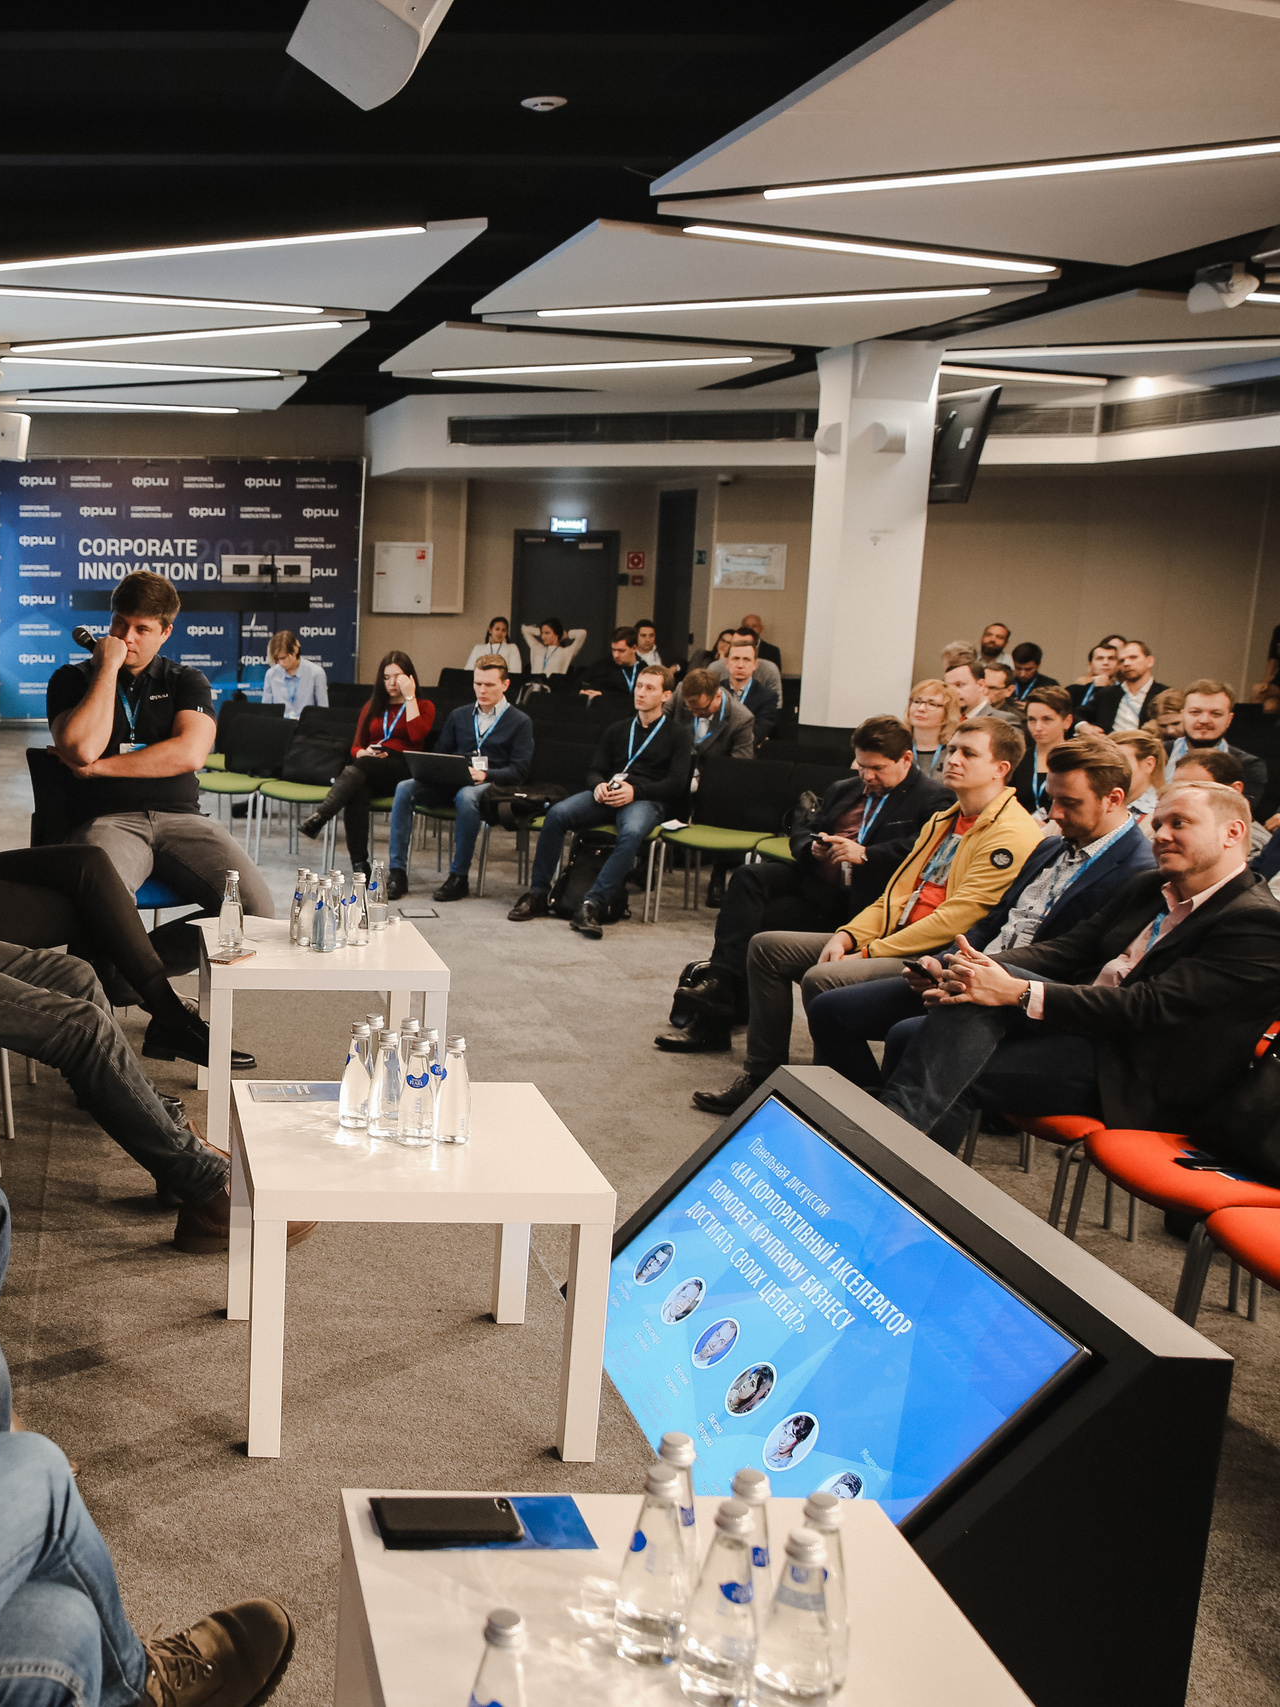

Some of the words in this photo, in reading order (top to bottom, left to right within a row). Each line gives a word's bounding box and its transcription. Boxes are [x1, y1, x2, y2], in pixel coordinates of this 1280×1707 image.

[78, 538, 198, 557] CORPORATE
[747, 1137, 791, 1181] Панельная
[784, 1175, 831, 1218] дискуссия
[685, 1200, 736, 1254] ДОСТИГАТЬ
[730, 1247, 768, 1289] СВОИХ
[758, 1279, 806, 1334] ЦЕЛЕЙ?»
[707, 1178, 758, 1230] ПОМОГАЕТ
[749, 1222, 808, 1282] КРУПНОМУ
[799, 1274, 856, 1331] БИЗНЕСУ
[730, 1160, 759, 1189] «КАК
[750, 1178, 840, 1265] КОРПОРАТИВНЫЙ
[827, 1256, 913, 1337] АКСЕЛЕРАТОР
[696, 1422, 714, 1448] Петрова
[708, 1412, 723, 1435] Оксана
